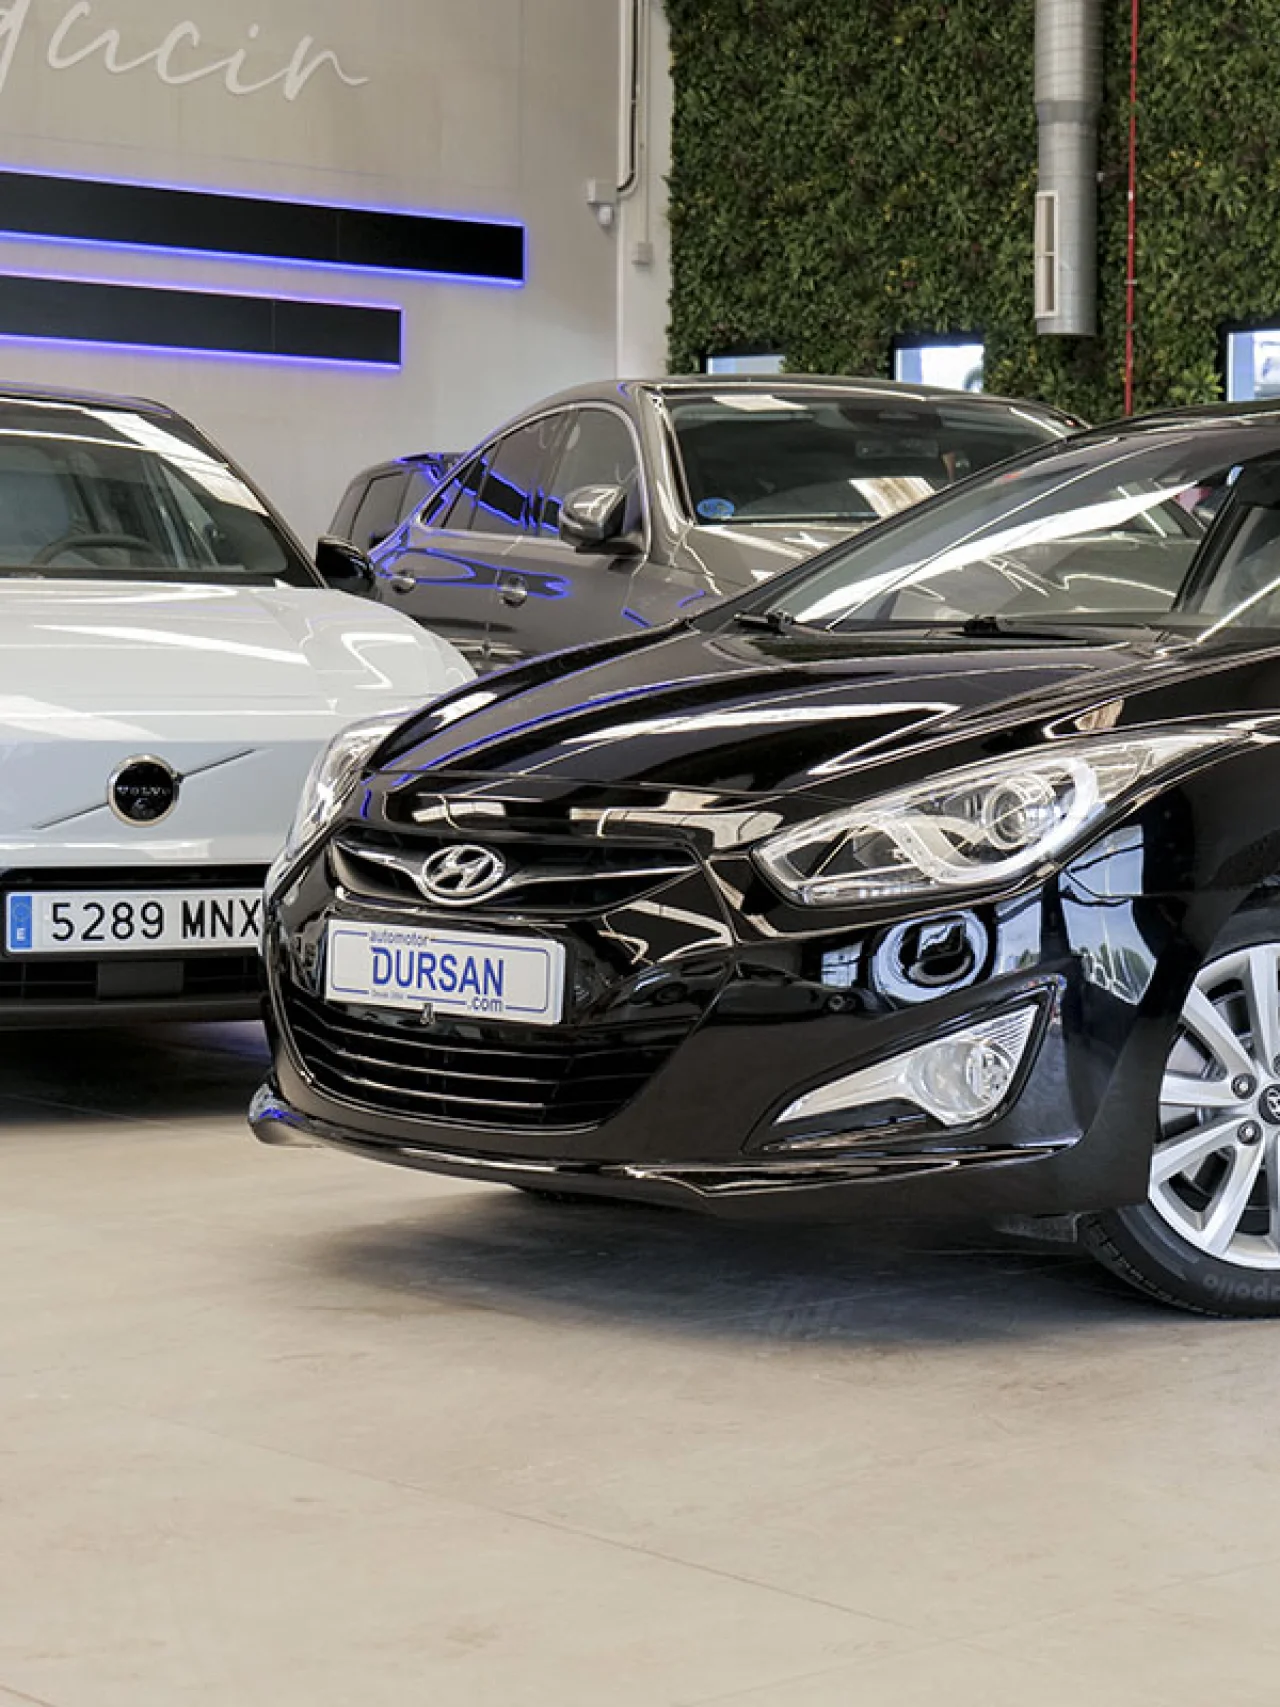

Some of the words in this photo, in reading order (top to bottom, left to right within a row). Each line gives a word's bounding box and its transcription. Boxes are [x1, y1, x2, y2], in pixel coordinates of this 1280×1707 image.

[51, 901, 164, 942] 5289
[182, 900, 260, 938] MNX
[16, 928, 25, 940] E
[369, 929, 430, 947] automotor
[370, 947, 504, 997] DURSAN
[467, 996, 503, 1012] .com
